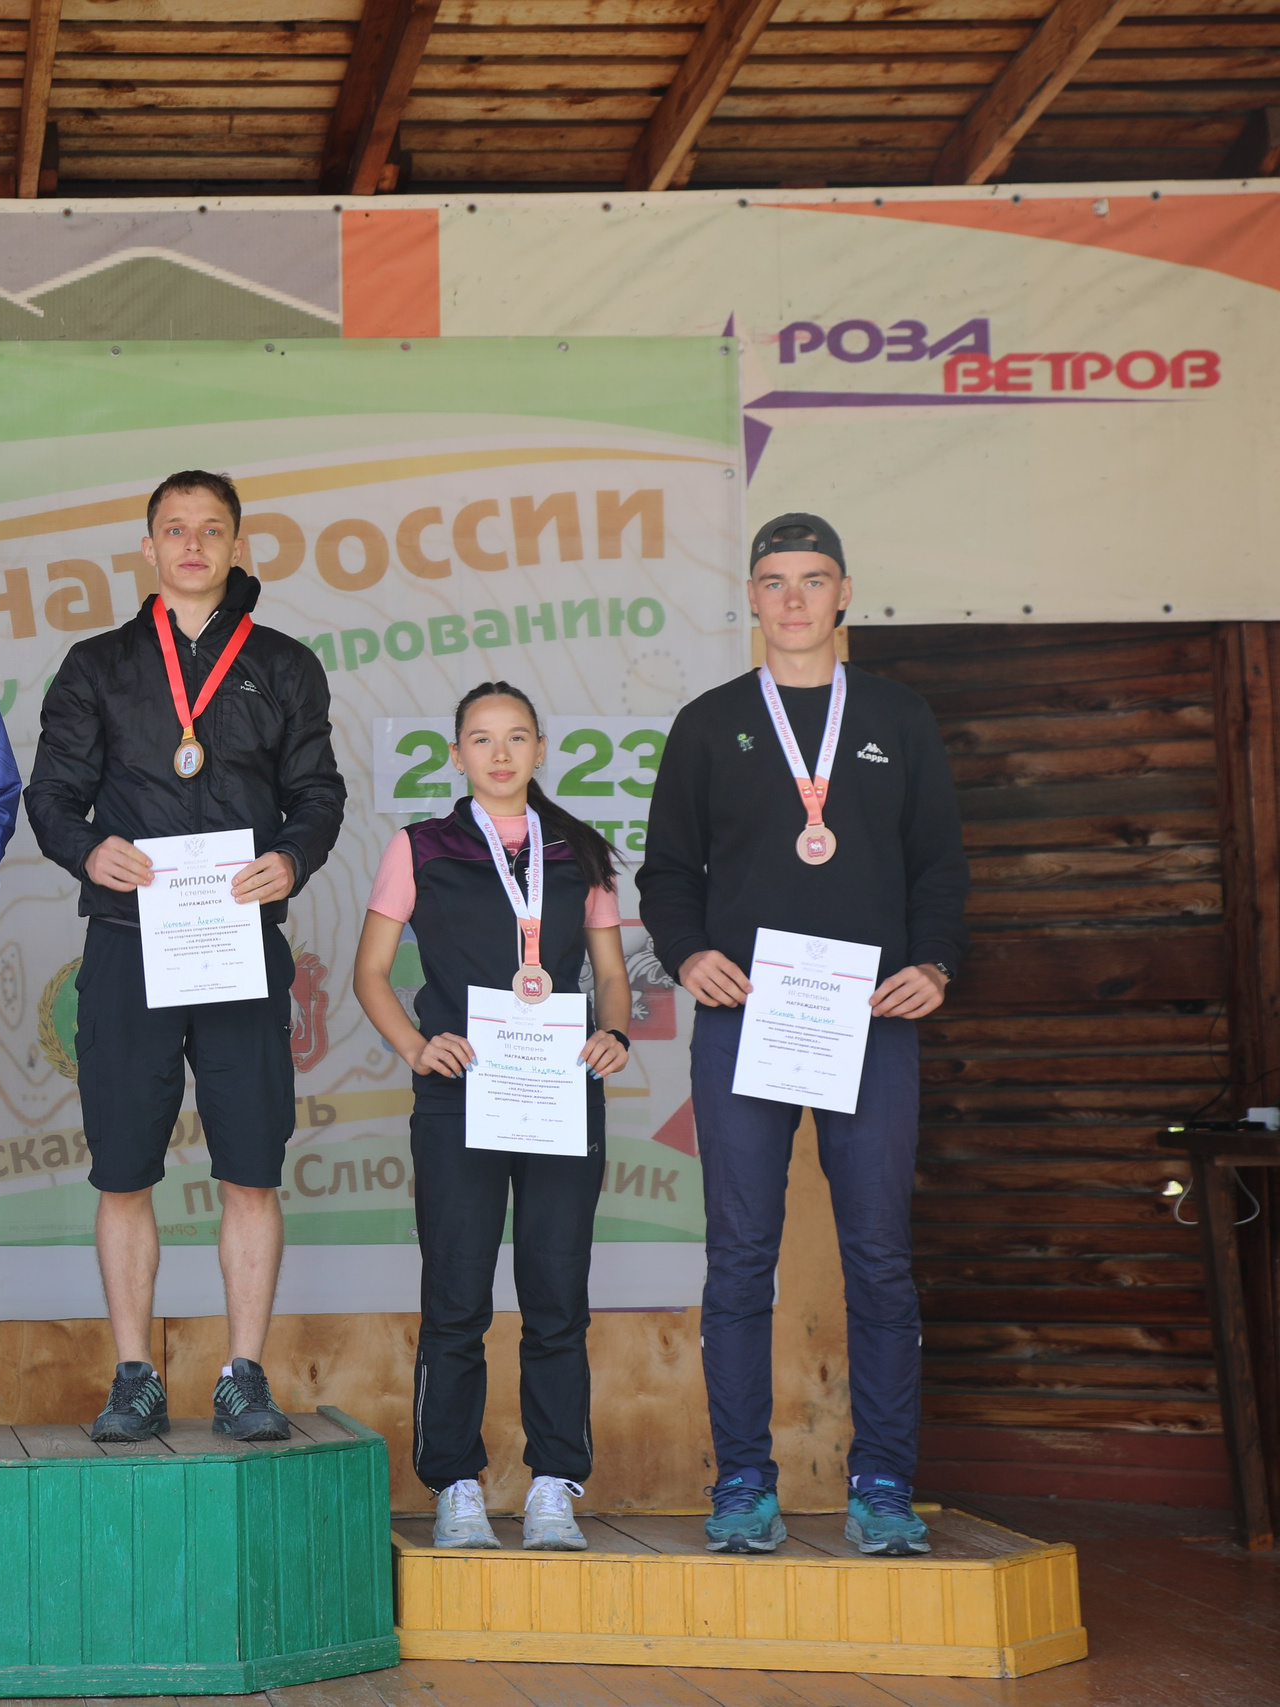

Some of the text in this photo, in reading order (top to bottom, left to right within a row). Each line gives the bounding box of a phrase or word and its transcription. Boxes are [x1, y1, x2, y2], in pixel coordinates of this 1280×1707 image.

[779, 318, 991, 364] РОЗА
[943, 349, 1221, 393] ВЕТРОВ
[857, 750, 889, 763] Kappa
[170, 874, 226, 888] ДИПЛОМ
[179, 899, 222, 907] НАГРАЖДАЕТСЯ
[782, 975, 840, 992] ДИПЛОМ
[798, 992, 829, 1001] степень
[786, 1001, 830, 1011] НАГРАЖДАЕТСЯ
[497, 1030, 553, 1042] ДИПЛОМ
[514, 1044, 544, 1052] степень
